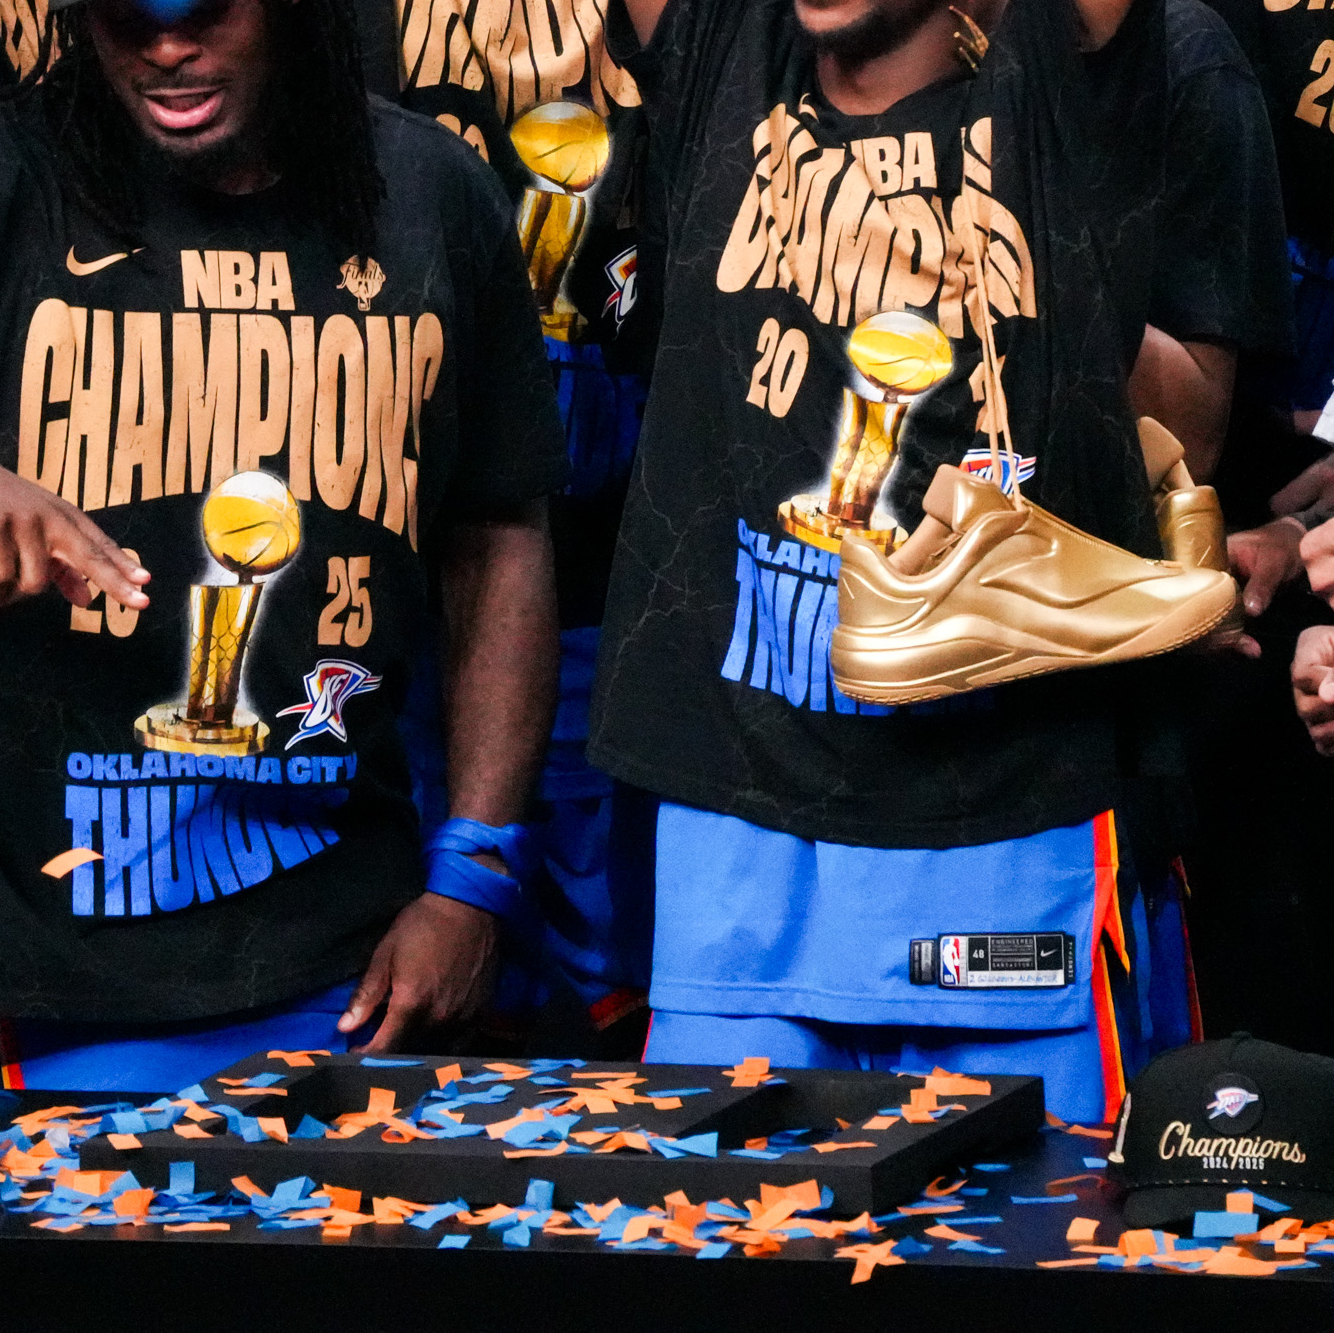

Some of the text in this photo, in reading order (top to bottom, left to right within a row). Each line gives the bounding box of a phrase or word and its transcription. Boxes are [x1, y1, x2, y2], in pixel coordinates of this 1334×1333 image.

[180, 250, 295, 310] NBA
[746, 317, 809, 418] 20
[18, 299, 444, 552] CHAMPIONS
[318, 556, 373, 647] 25
[67, 751, 358, 785] OKLAHOMA CITY
[972, 949, 985, 959] 48
[1159, 1121, 1307, 1170] Champions
